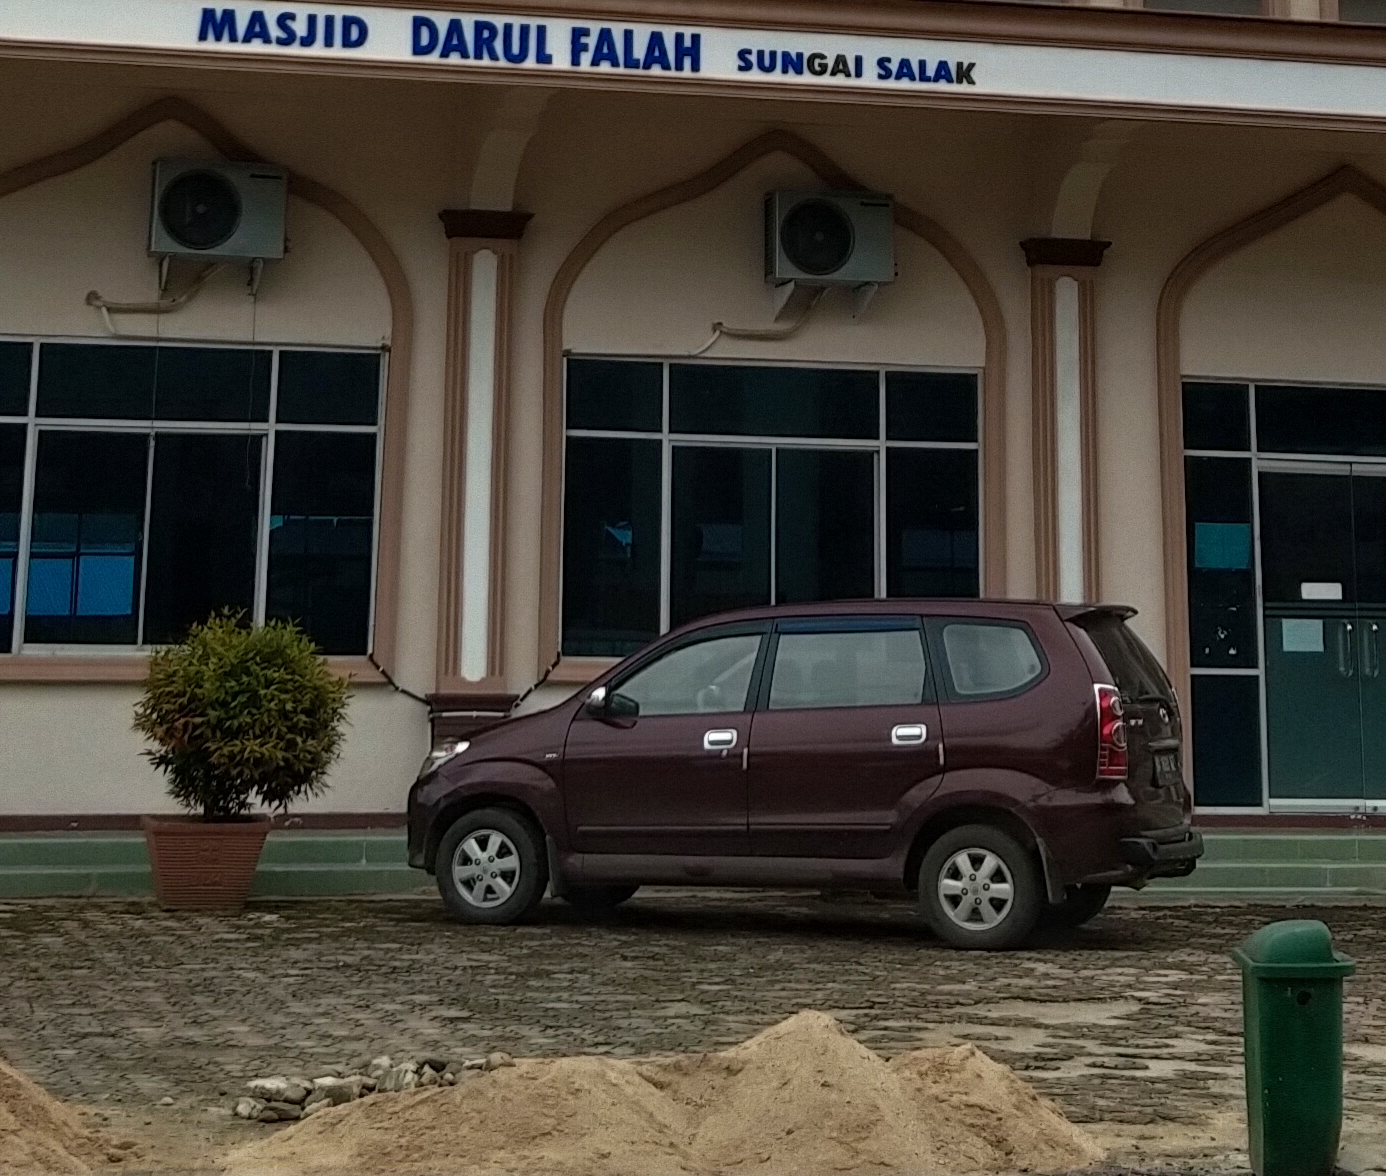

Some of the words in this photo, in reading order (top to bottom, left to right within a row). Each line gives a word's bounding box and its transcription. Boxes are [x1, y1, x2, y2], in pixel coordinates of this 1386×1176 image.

[198, 8, 369, 49] MASJID
[412, 15, 553, 65] DARUL
[570, 26, 701, 73] FALAH
[737, 48, 863, 79] SUNGAI
[876, 56, 976, 86] SALAK
